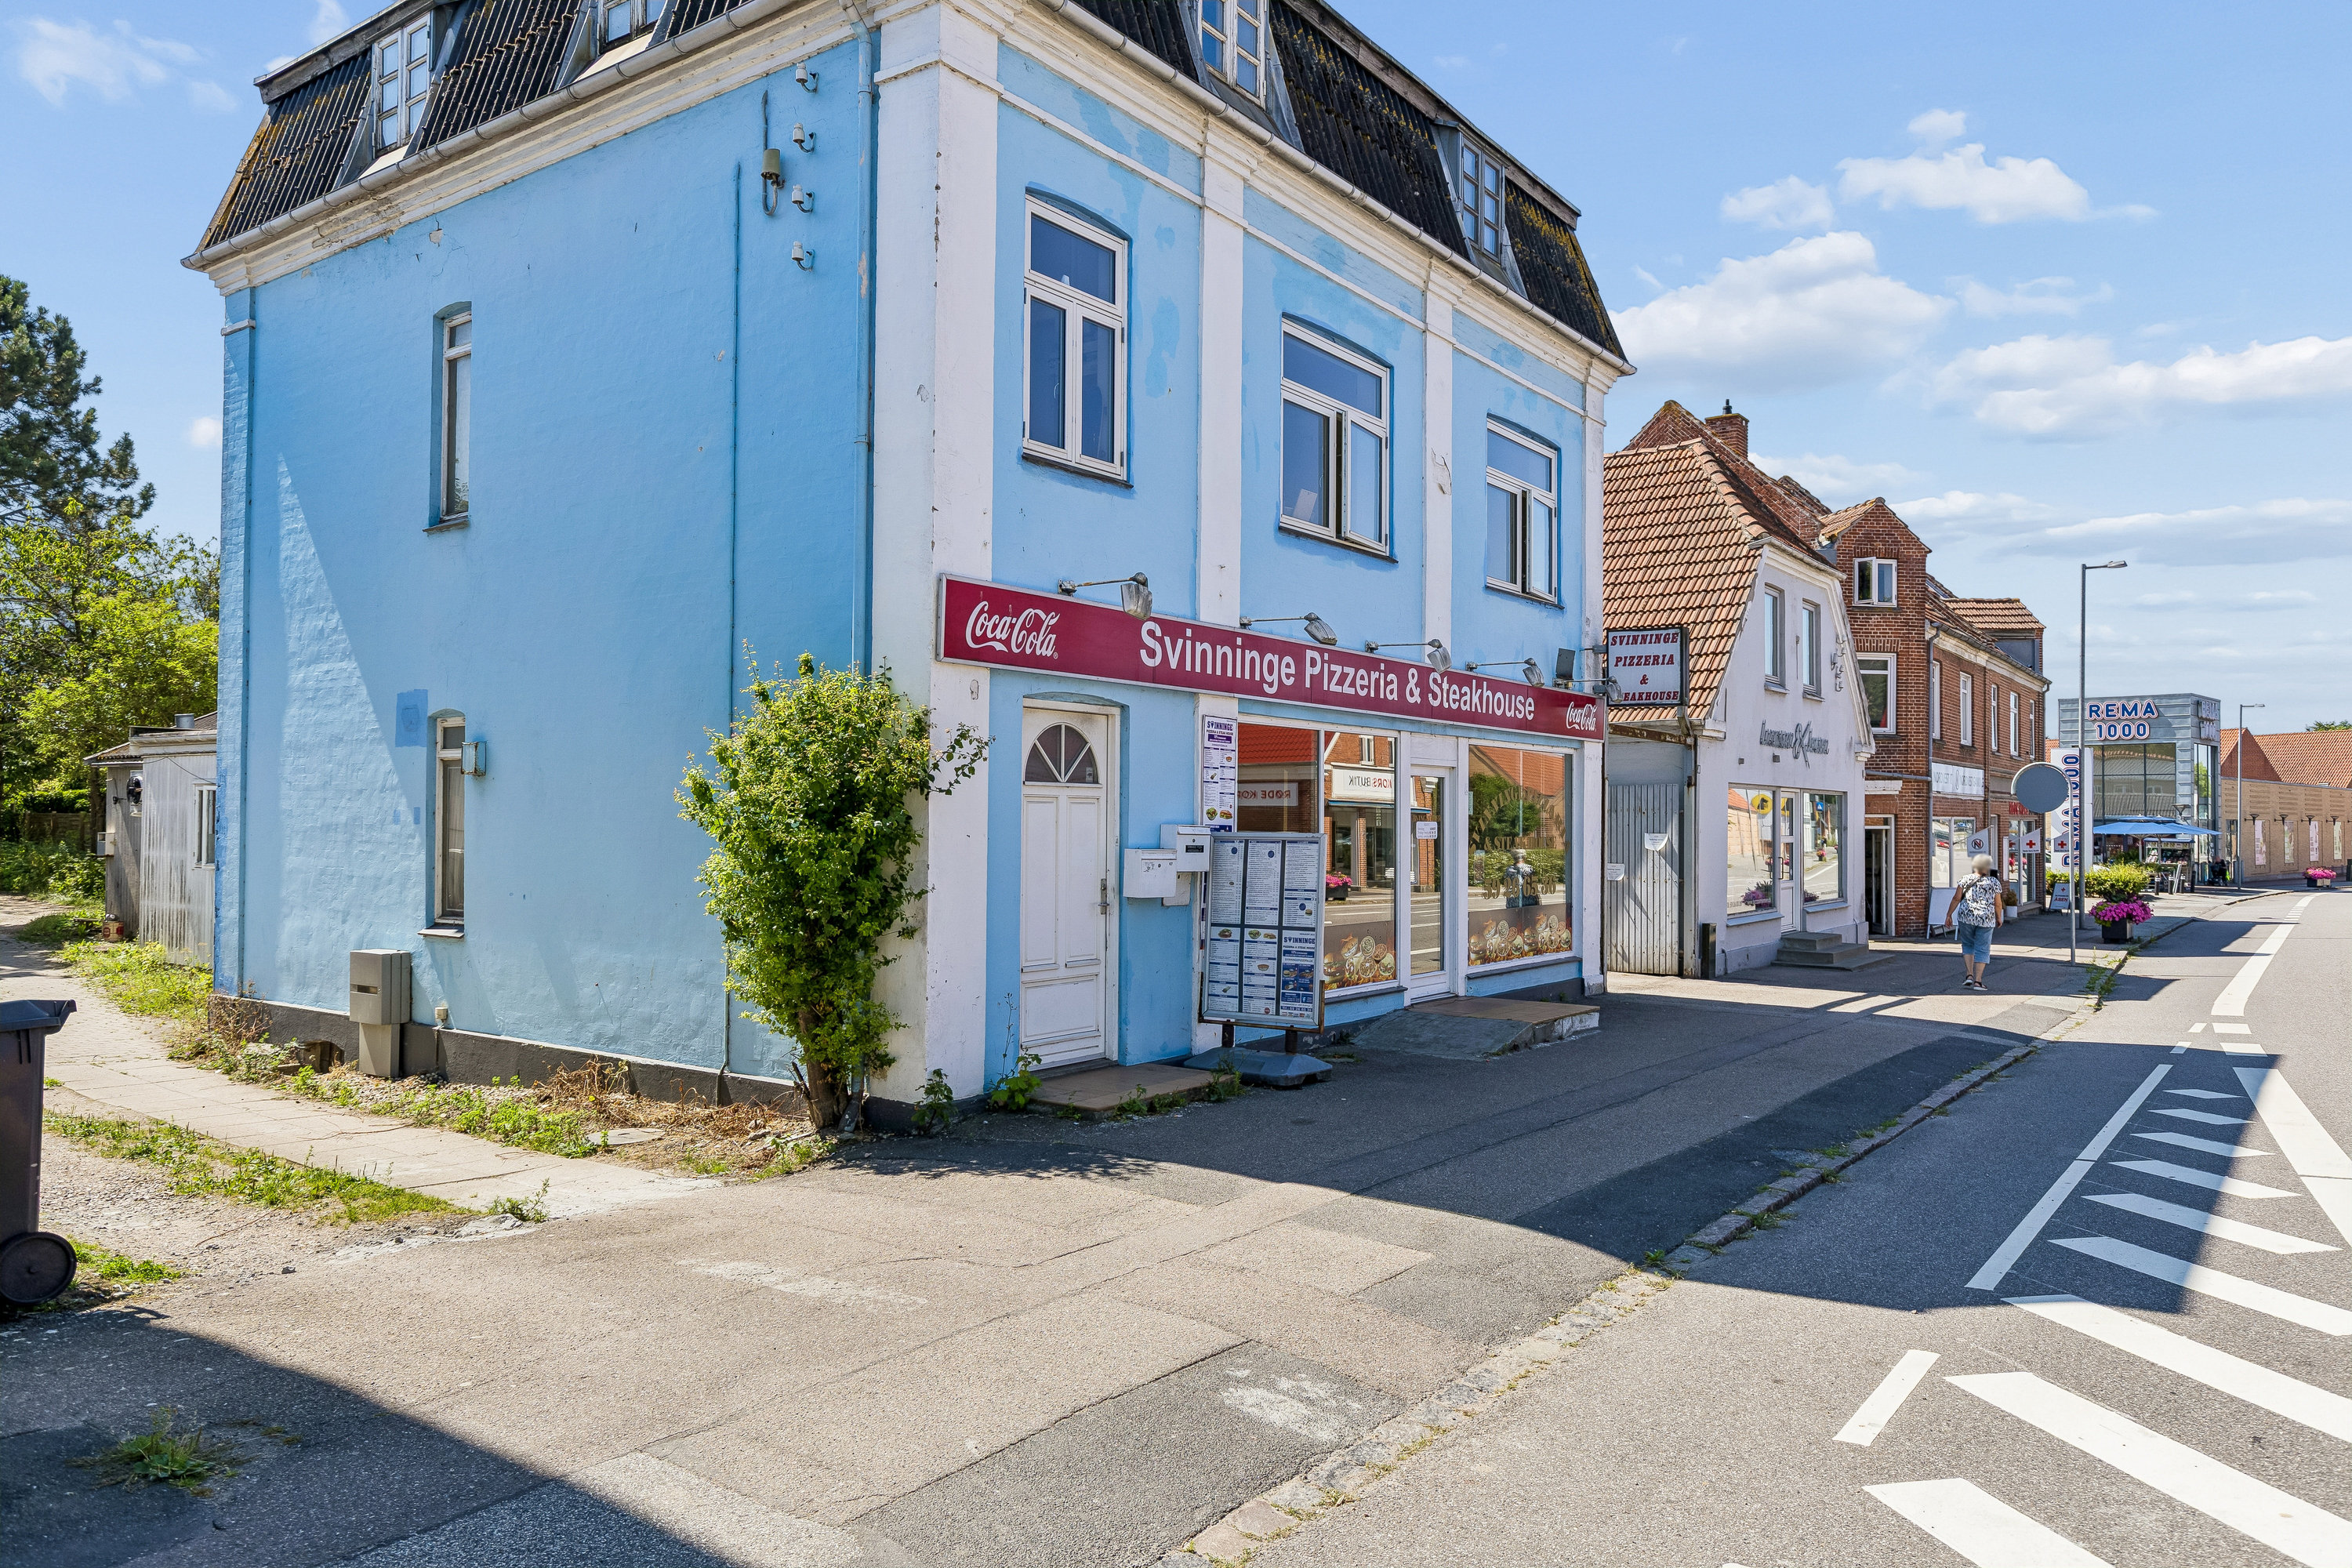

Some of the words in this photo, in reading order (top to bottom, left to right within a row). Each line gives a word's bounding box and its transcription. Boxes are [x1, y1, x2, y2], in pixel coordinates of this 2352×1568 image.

[965, 601, 1060, 657] Coca-Cola
[1610, 633, 1679, 646] SVINNINGE
[1614, 654, 1675, 667] PIZZERIA
[1140, 621, 1295, 694] Svinninge
[1305, 649, 1398, 701] Pizzeria
[1406, 668, 1421, 705] &
[1428, 671, 1535, 720] Steakhouse
[1639, 673, 1649, 685] &
[1623, 691, 1679, 702] EAKHOUSE
[1566, 701, 1599, 731] Coca-Cola
[2087, 700, 2158, 720] REMA
[2095, 721, 2150, 740] 1000
[1484, 837, 1492, 851] &
[1483, 878, 1501, 899] 59
[1504, 877, 1520, 898] 26
[1523, 875, 1539, 897] 65
